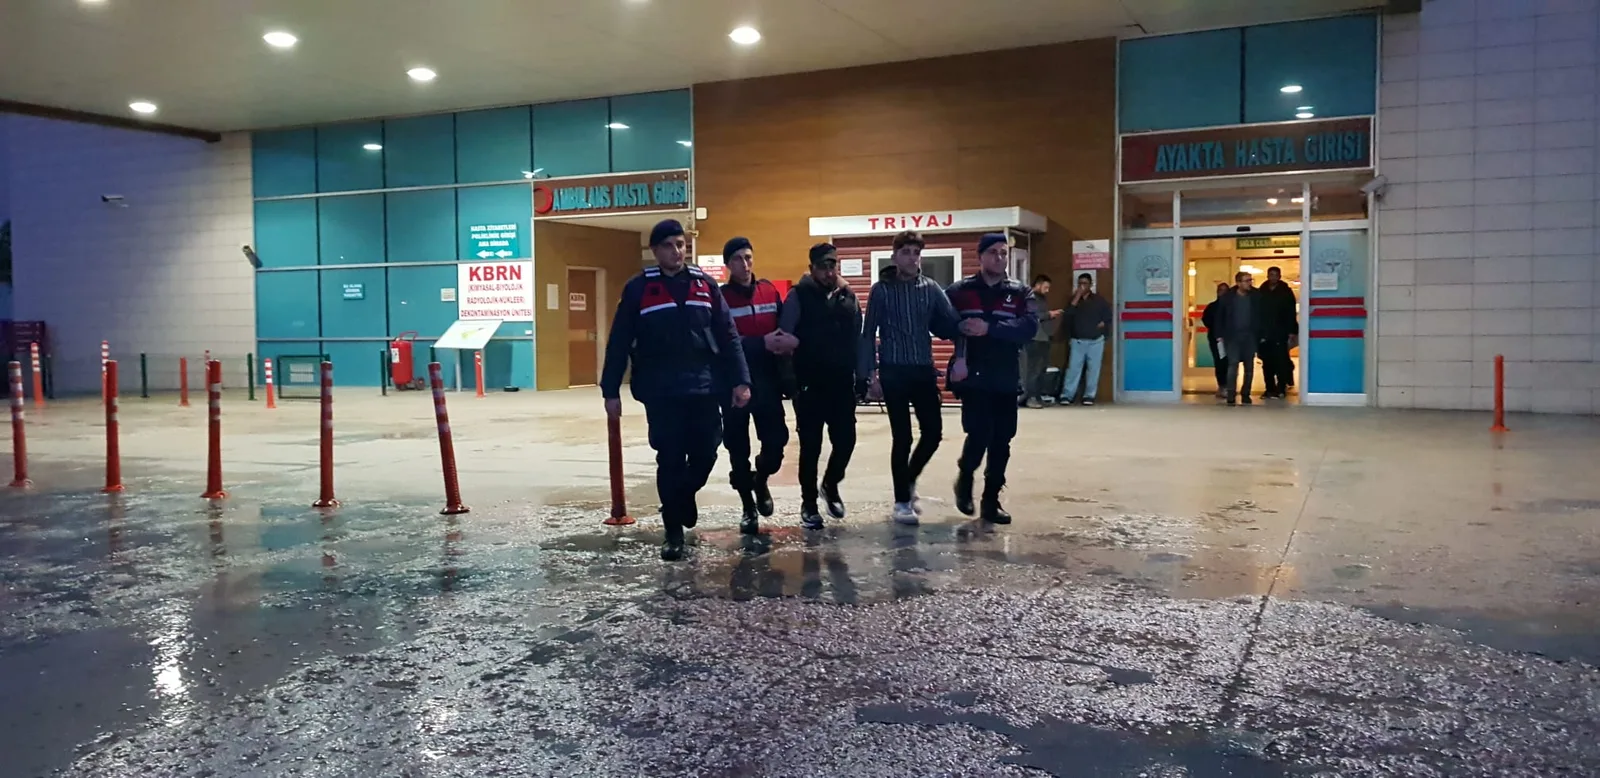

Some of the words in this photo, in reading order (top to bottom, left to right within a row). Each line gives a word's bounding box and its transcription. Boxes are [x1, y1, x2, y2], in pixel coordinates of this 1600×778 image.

[1155, 140, 1224, 172] AYAKTA
[1235, 136, 1296, 167] HASTA
[552, 185, 611, 212] AMBULANS
[613, 182, 650, 207] HASTA
[469, 264, 521, 282] KBRN
